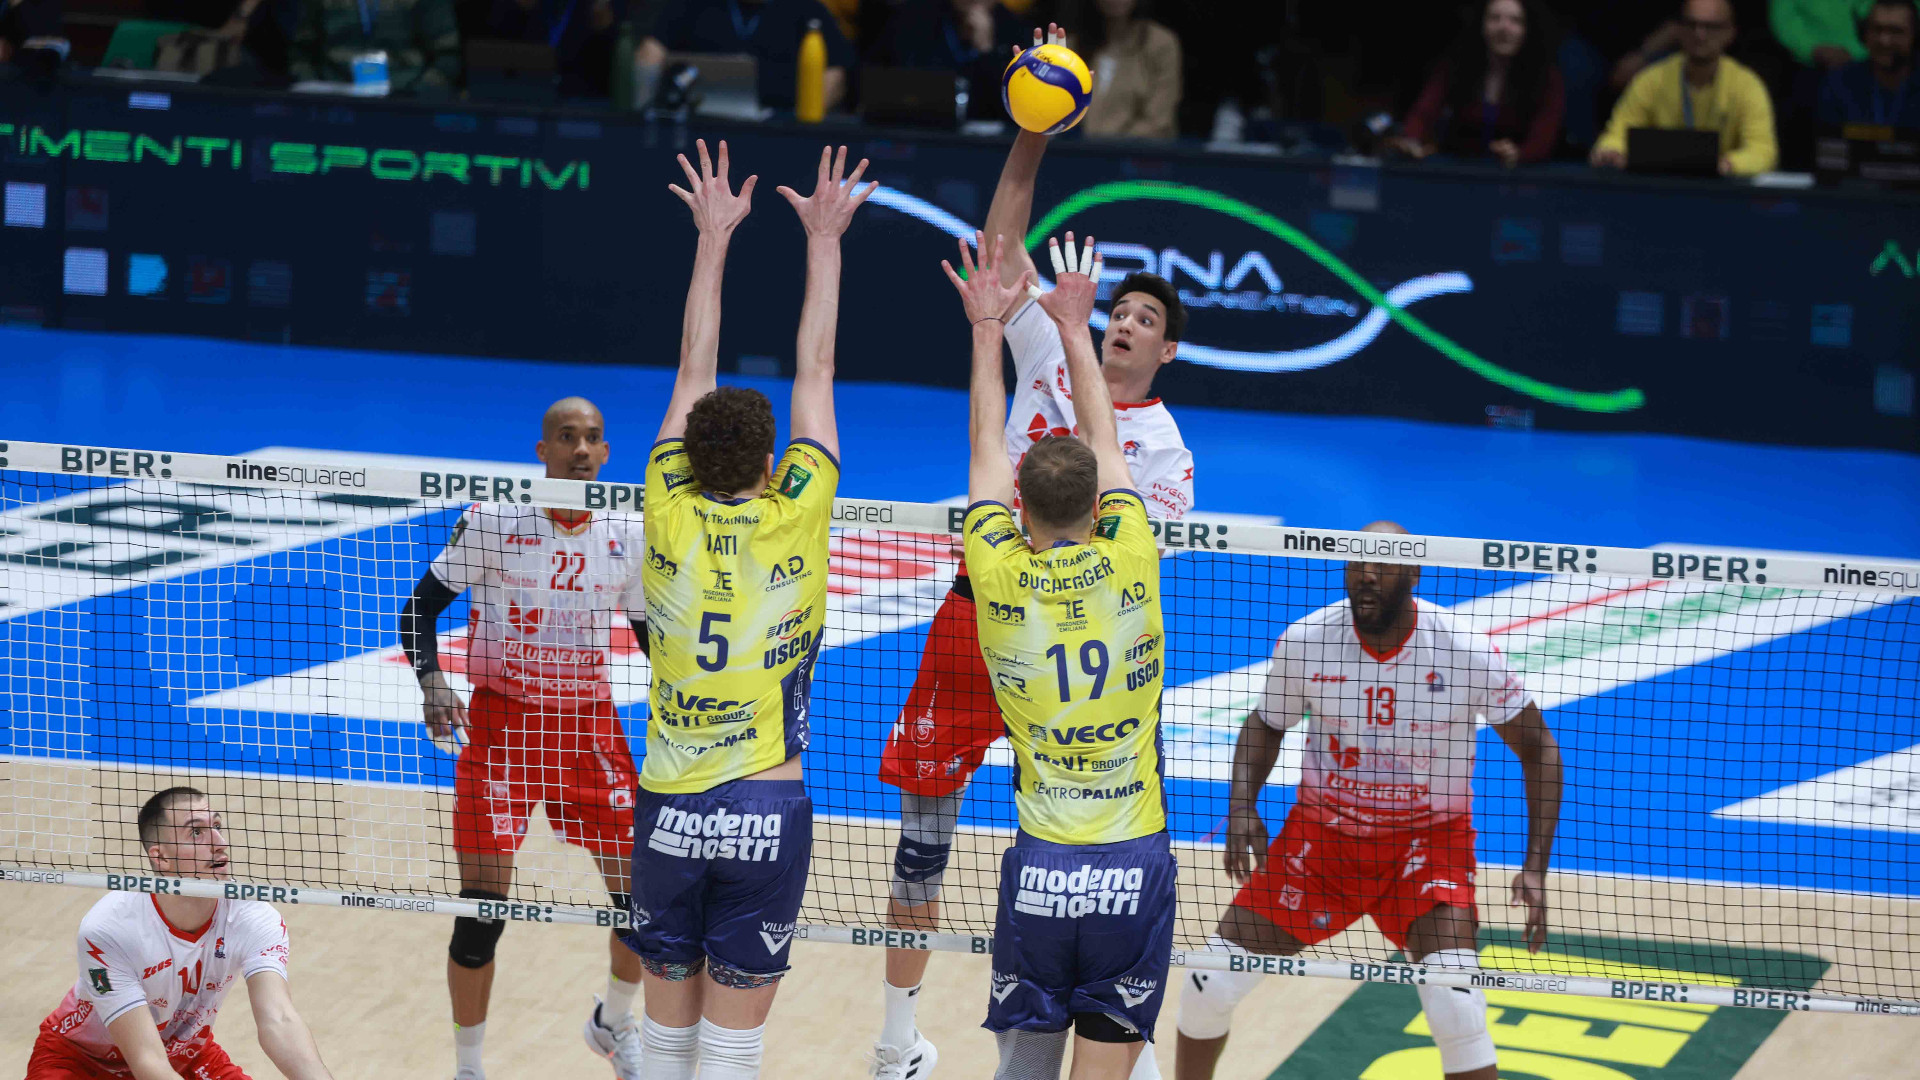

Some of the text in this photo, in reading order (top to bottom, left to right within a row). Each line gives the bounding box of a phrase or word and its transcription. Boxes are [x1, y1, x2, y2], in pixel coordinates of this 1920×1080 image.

[270, 142, 590, 190] SPORTIVI
[226, 459, 366, 488] ninesquared
[585, 483, 645, 512] BPE
[1147, 520, 1228, 549] PER:
[1284, 530, 1427, 559] ninesquared
[1824, 563, 1919, 592] ninesqu
[551, 550, 586, 592] 22
[765, 570, 813, 592] CONSULTING
[1018, 556, 1115, 594] BUCHEGGER
[1117, 596, 1152, 617] CONSULTING
[696, 611, 731, 673] 5
[1059, 625, 1087, 633] EMILIANA
[764, 630, 812, 670] USCO
[1046, 639, 1110, 703] 19
[1126, 658, 1159, 691] USCO
[706, 710, 746, 723] GROUP
[1363, 686, 1395, 726] 13
[1052, 718, 1140, 745] VECO
[1091, 756, 1128, 770] GROUP
[656, 805, 782, 838] modena
[1019, 864, 1143, 893] modena
[0, 869, 64, 884] squared
[341, 893, 435, 913] ninesquared
[1471, 972, 1567, 992] ninesquared
[178, 959, 203, 996] 10
